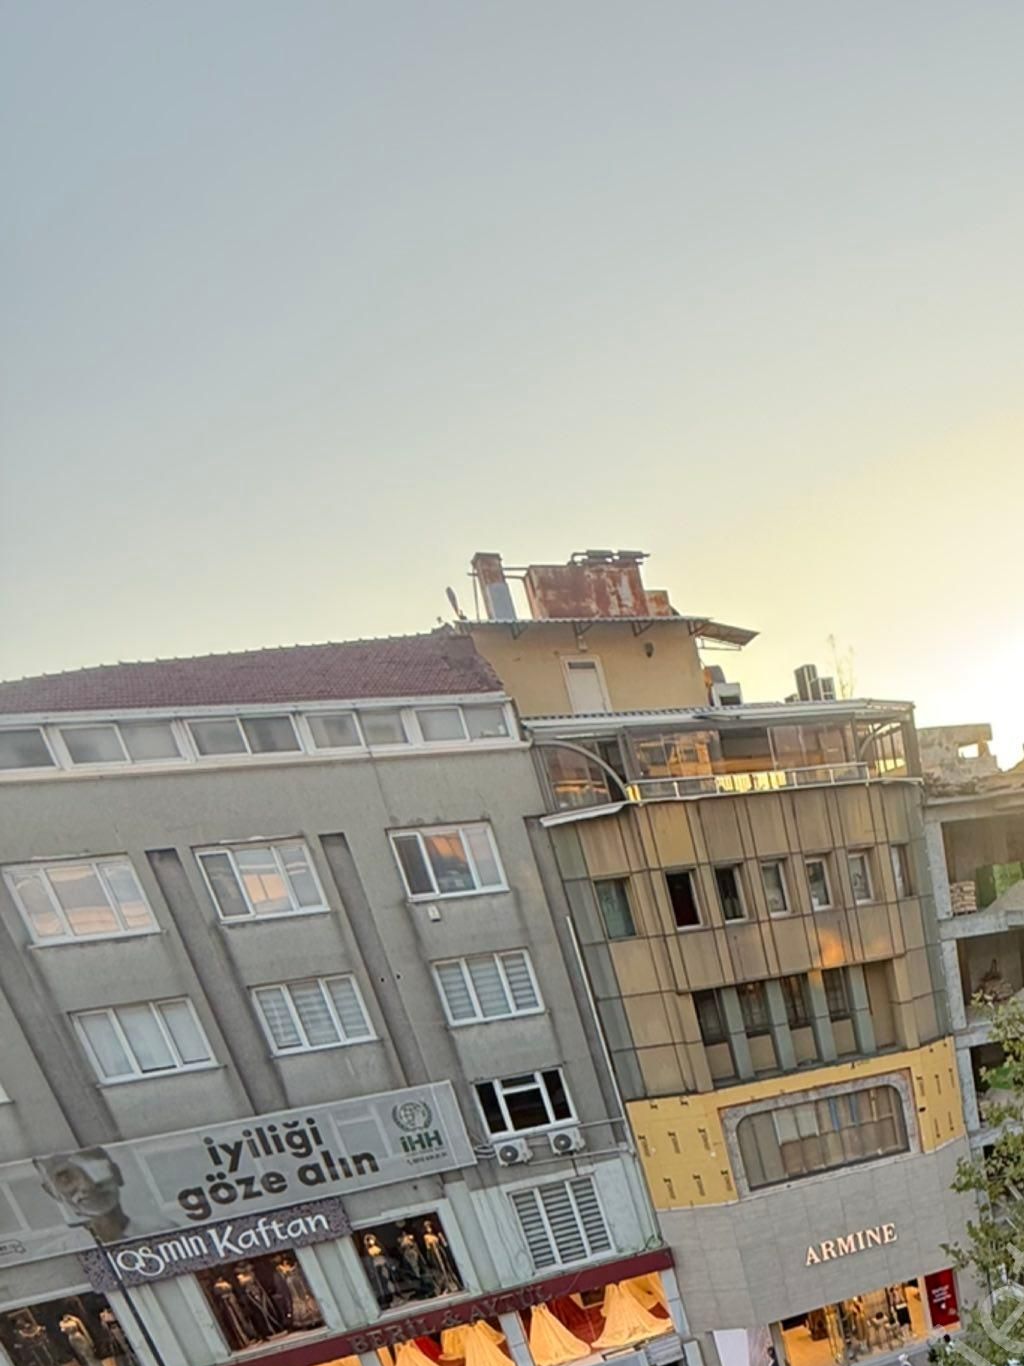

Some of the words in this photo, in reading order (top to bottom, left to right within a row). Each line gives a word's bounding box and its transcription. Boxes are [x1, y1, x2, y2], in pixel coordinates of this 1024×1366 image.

[203, 1117, 325, 1174] iyiliği
[177, 1169, 288, 1221] göze
[297, 1150, 380, 1186] alın
[207, 1213, 330, 1259] Kaftan
[805, 1222, 898, 1267] ARMINE
